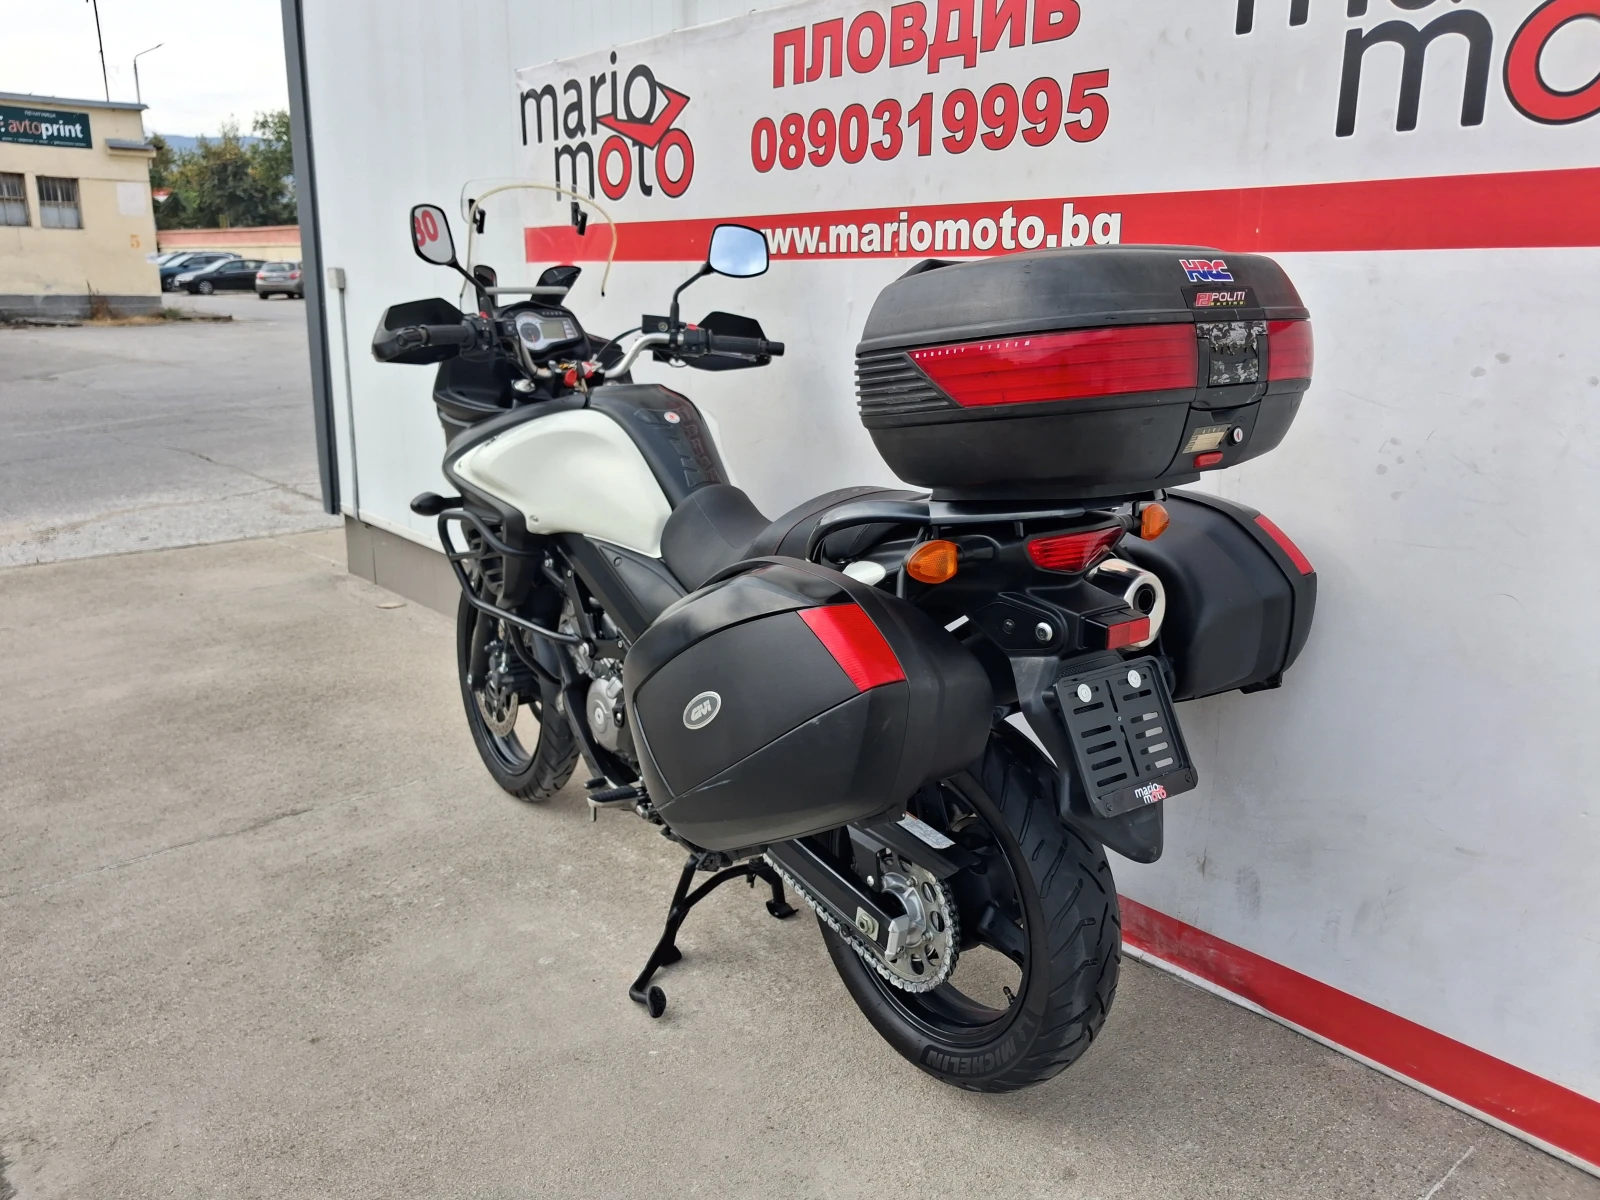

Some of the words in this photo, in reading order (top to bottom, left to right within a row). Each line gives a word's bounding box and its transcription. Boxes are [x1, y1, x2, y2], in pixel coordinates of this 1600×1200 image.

[773, 0, 1081, 89] ПЛОВДИВ
[520, 51, 657, 146] mario
[751, 69, 1110, 174] 0890319995
[8, 119, 84, 140] avtoprint
[554, 128, 695, 201] moto
[759, 202, 1122, 255] ww.mariomoto.bg
[1179, 259, 1235, 282] HRC
[1211, 291, 1246, 302] POLITI
[1134, 782, 1159, 799] mario
[926, 1036, 1018, 1075] MICHELIN
